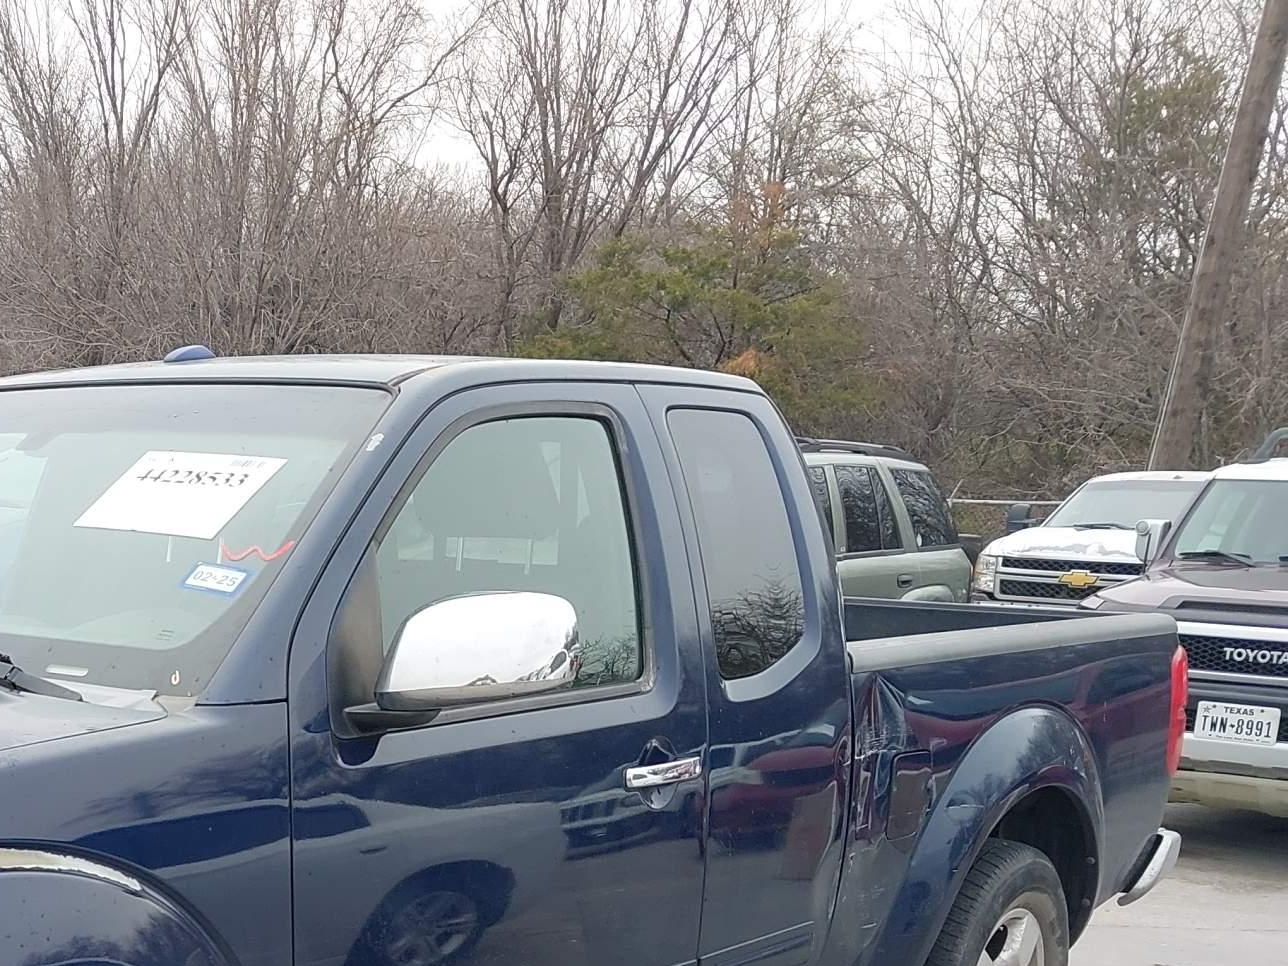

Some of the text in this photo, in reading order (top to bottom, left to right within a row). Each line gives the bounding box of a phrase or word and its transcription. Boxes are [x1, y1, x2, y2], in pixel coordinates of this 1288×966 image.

[136, 468, 250, 487] 44228533
[1223, 647, 1288, 665] TOYOTA
[1224, 706, 1255, 716] TEXAS
